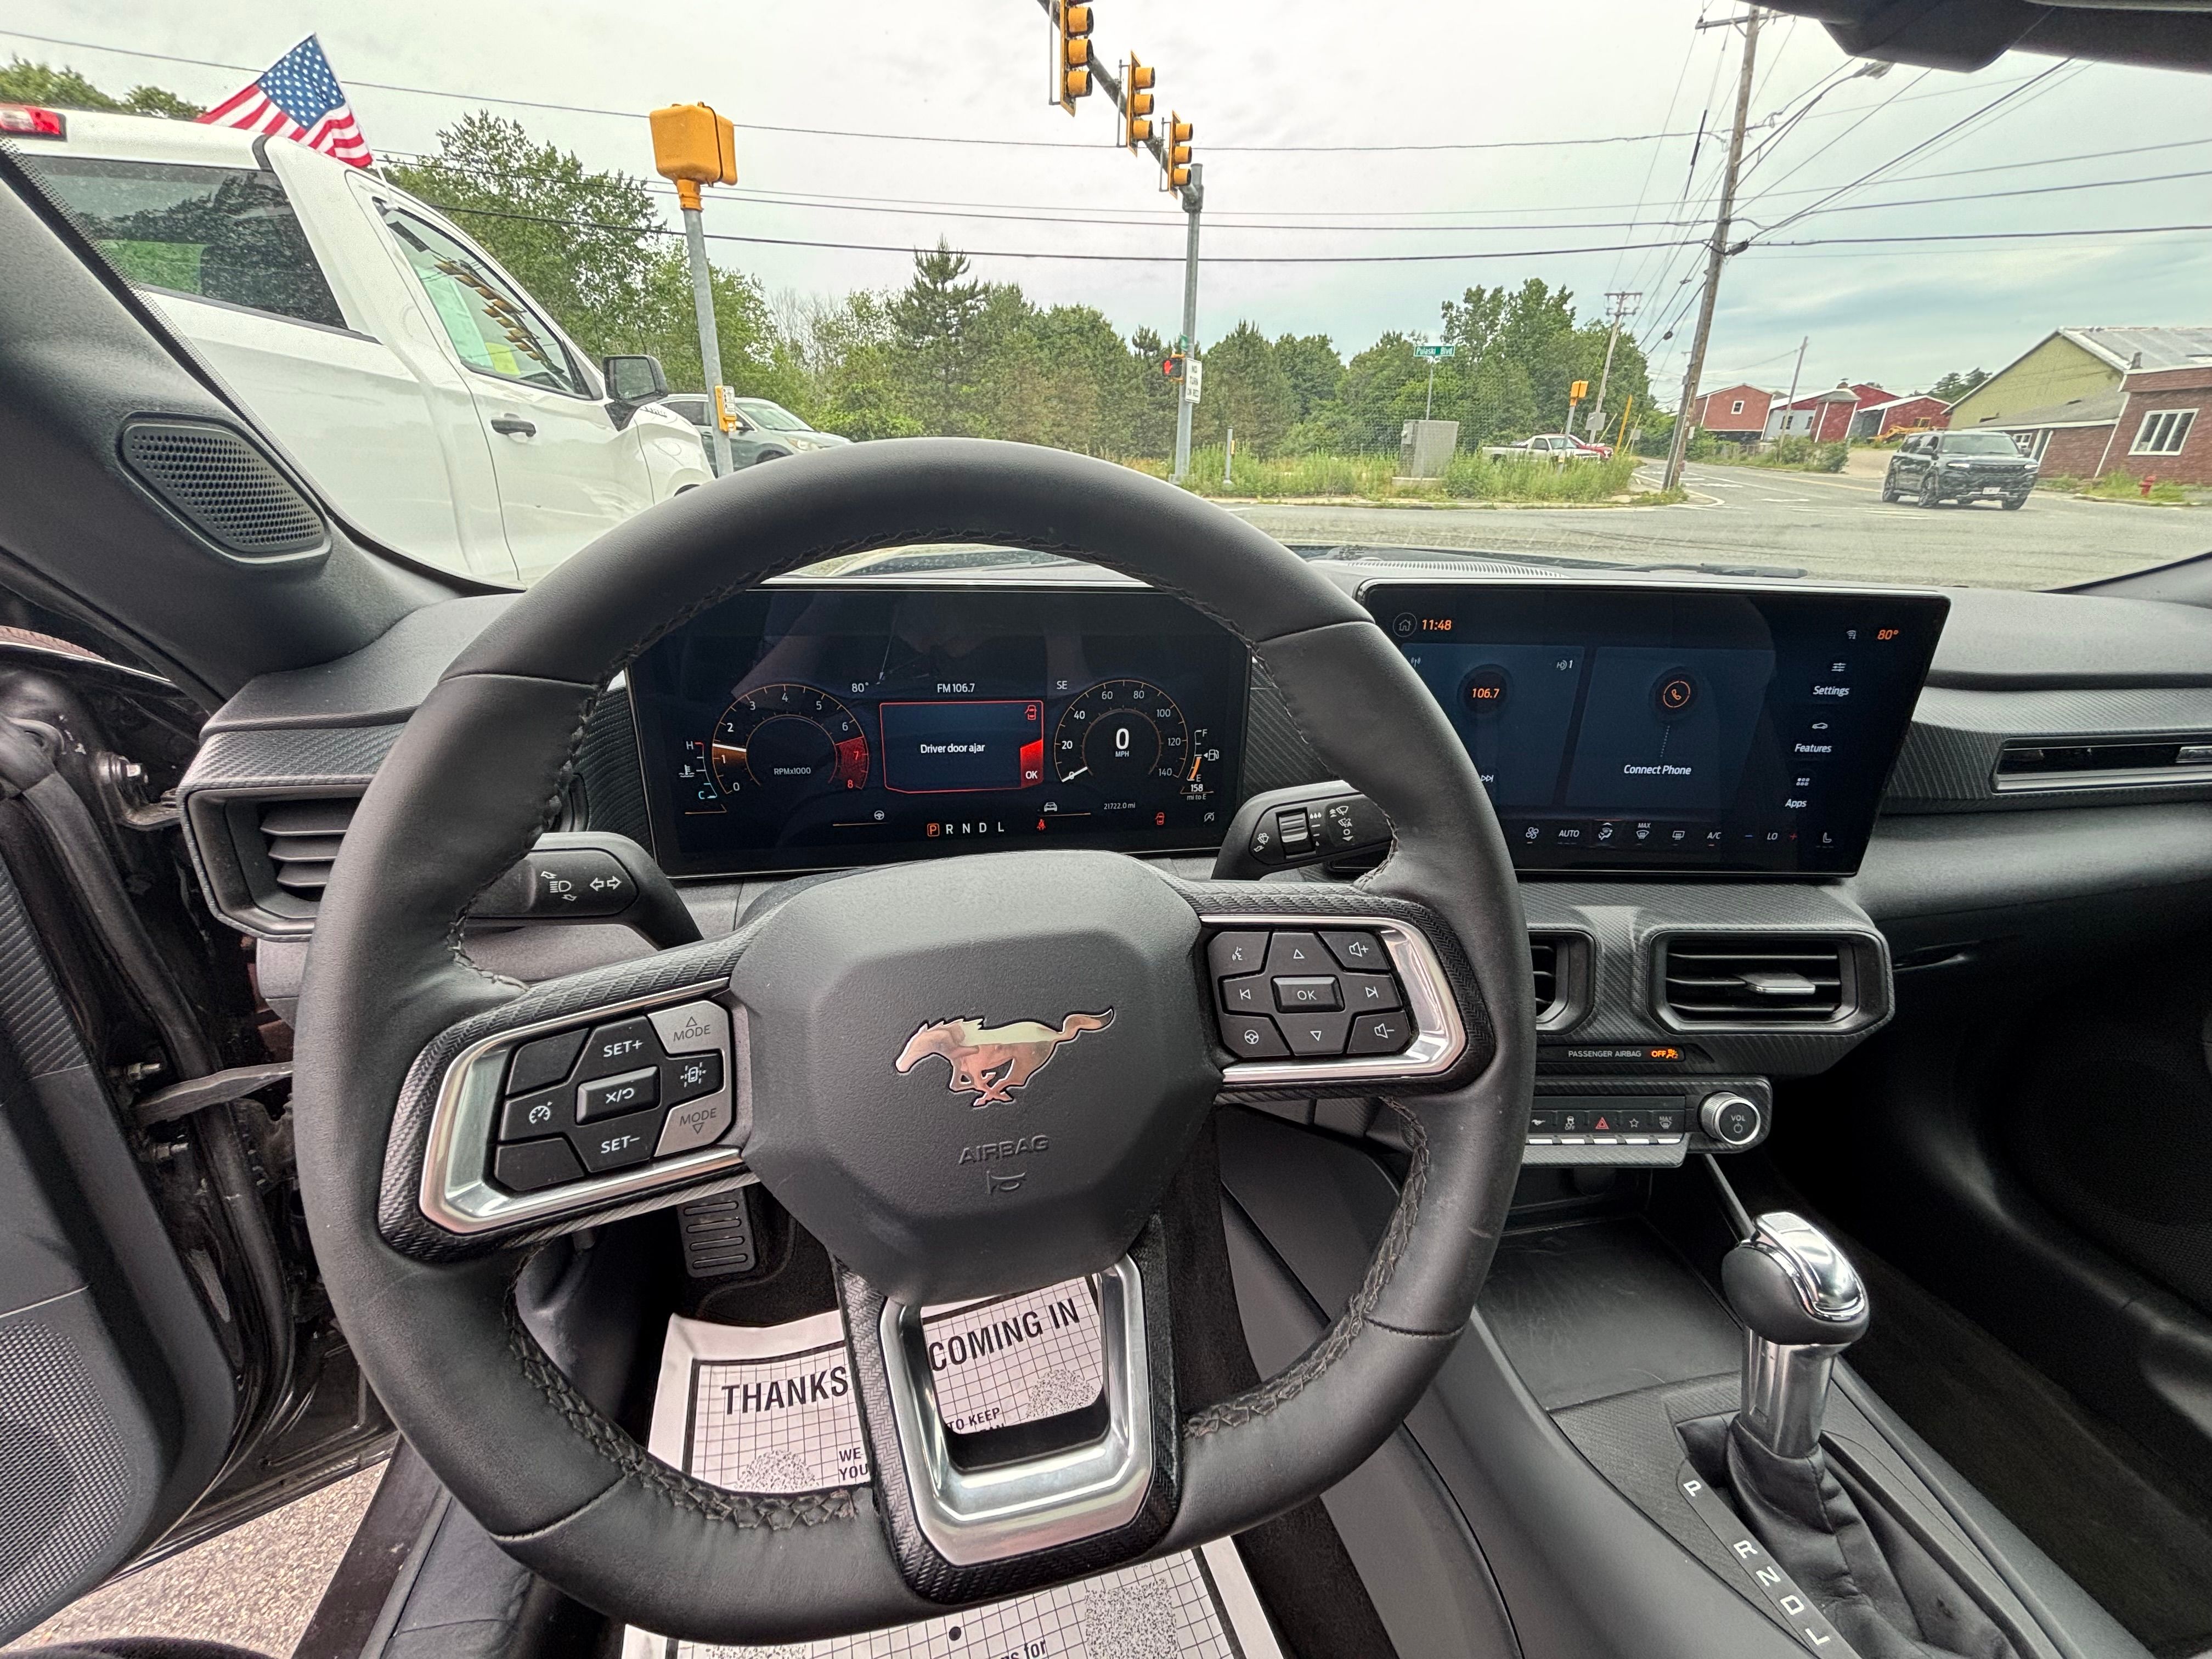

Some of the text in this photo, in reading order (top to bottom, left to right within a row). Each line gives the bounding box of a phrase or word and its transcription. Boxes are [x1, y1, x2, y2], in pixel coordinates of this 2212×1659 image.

[1416, 347, 1453, 355] Pulaski Blvd
[1422, 619, 1452, 630] 11:48
[1877, 630, 1899, 640] 80°
[851, 682, 868, 692] 80°
[937, 683, 975, 693] FM 106.7
[1057, 681, 1067, 690] SE
[1102, 691, 1113, 700] 60
[1133, 691, 1144, 699] 80
[1472, 688, 1500, 698] 106.7
[1813, 686, 1849, 696] Settings
[781, 693, 788, 702] 4
[749, 702, 756, 710] 3
[816, 701, 822, 710] 5
[1074, 711, 1085, 720] 40
[1157, 709, 1171, 717] 100
[727, 723, 734, 732] 2
[842, 723, 848, 731] 6
[1116, 728, 1129, 749] 0
[1168, 738, 1181, 746] 120
[686, 741, 693, 749] H
[921, 743, 985, 753] Driver door ajar
[1062, 741, 1073, 749] 20
[1794, 743, 1832, 753] Features
[721, 755, 726, 764] 1
[853, 751, 860, 760] 7
[774, 767, 811, 775] RPMx1000
[1025, 771, 1038, 779] OK
[1159, 768, 1172, 776] 140
[1624, 765, 1691, 776] Connect Phone
[732, 782, 740, 792] 0
[847, 780, 854, 788] 8
[698, 791, 705, 799] C
[1785, 798, 1807, 809] Apps
[929, 822, 1005, 834] P R N D L
[1558, 830, 1579, 838] AUTO
[1707, 832, 1721, 840] A/C
[1767, 832, 1778, 840] LO
[1297, 990, 1317, 1000] OK
[673, 1025, 710, 1041] MODE
[603, 1040, 642, 1057] SET+
[680, 1108, 716, 1126] MODE
[958, 1135, 1048, 1164] AIRBAG
[721, 1298, 1081, 1415] THANKS COMING IN
[839, 1447, 861, 1463] WE
[968, 1407, 1000, 1426] KEEP
[839, 1463, 868, 1481] YOU
[1684, 1480, 1701, 1496] P
[1734, 1540, 1758, 1558] R
[1756, 1566, 1780, 1586] N
[1780, 1595, 1804, 1615] D
[1805, 1628, 1830, 1645] L
[1024, 1639, 1046, 1659] for
